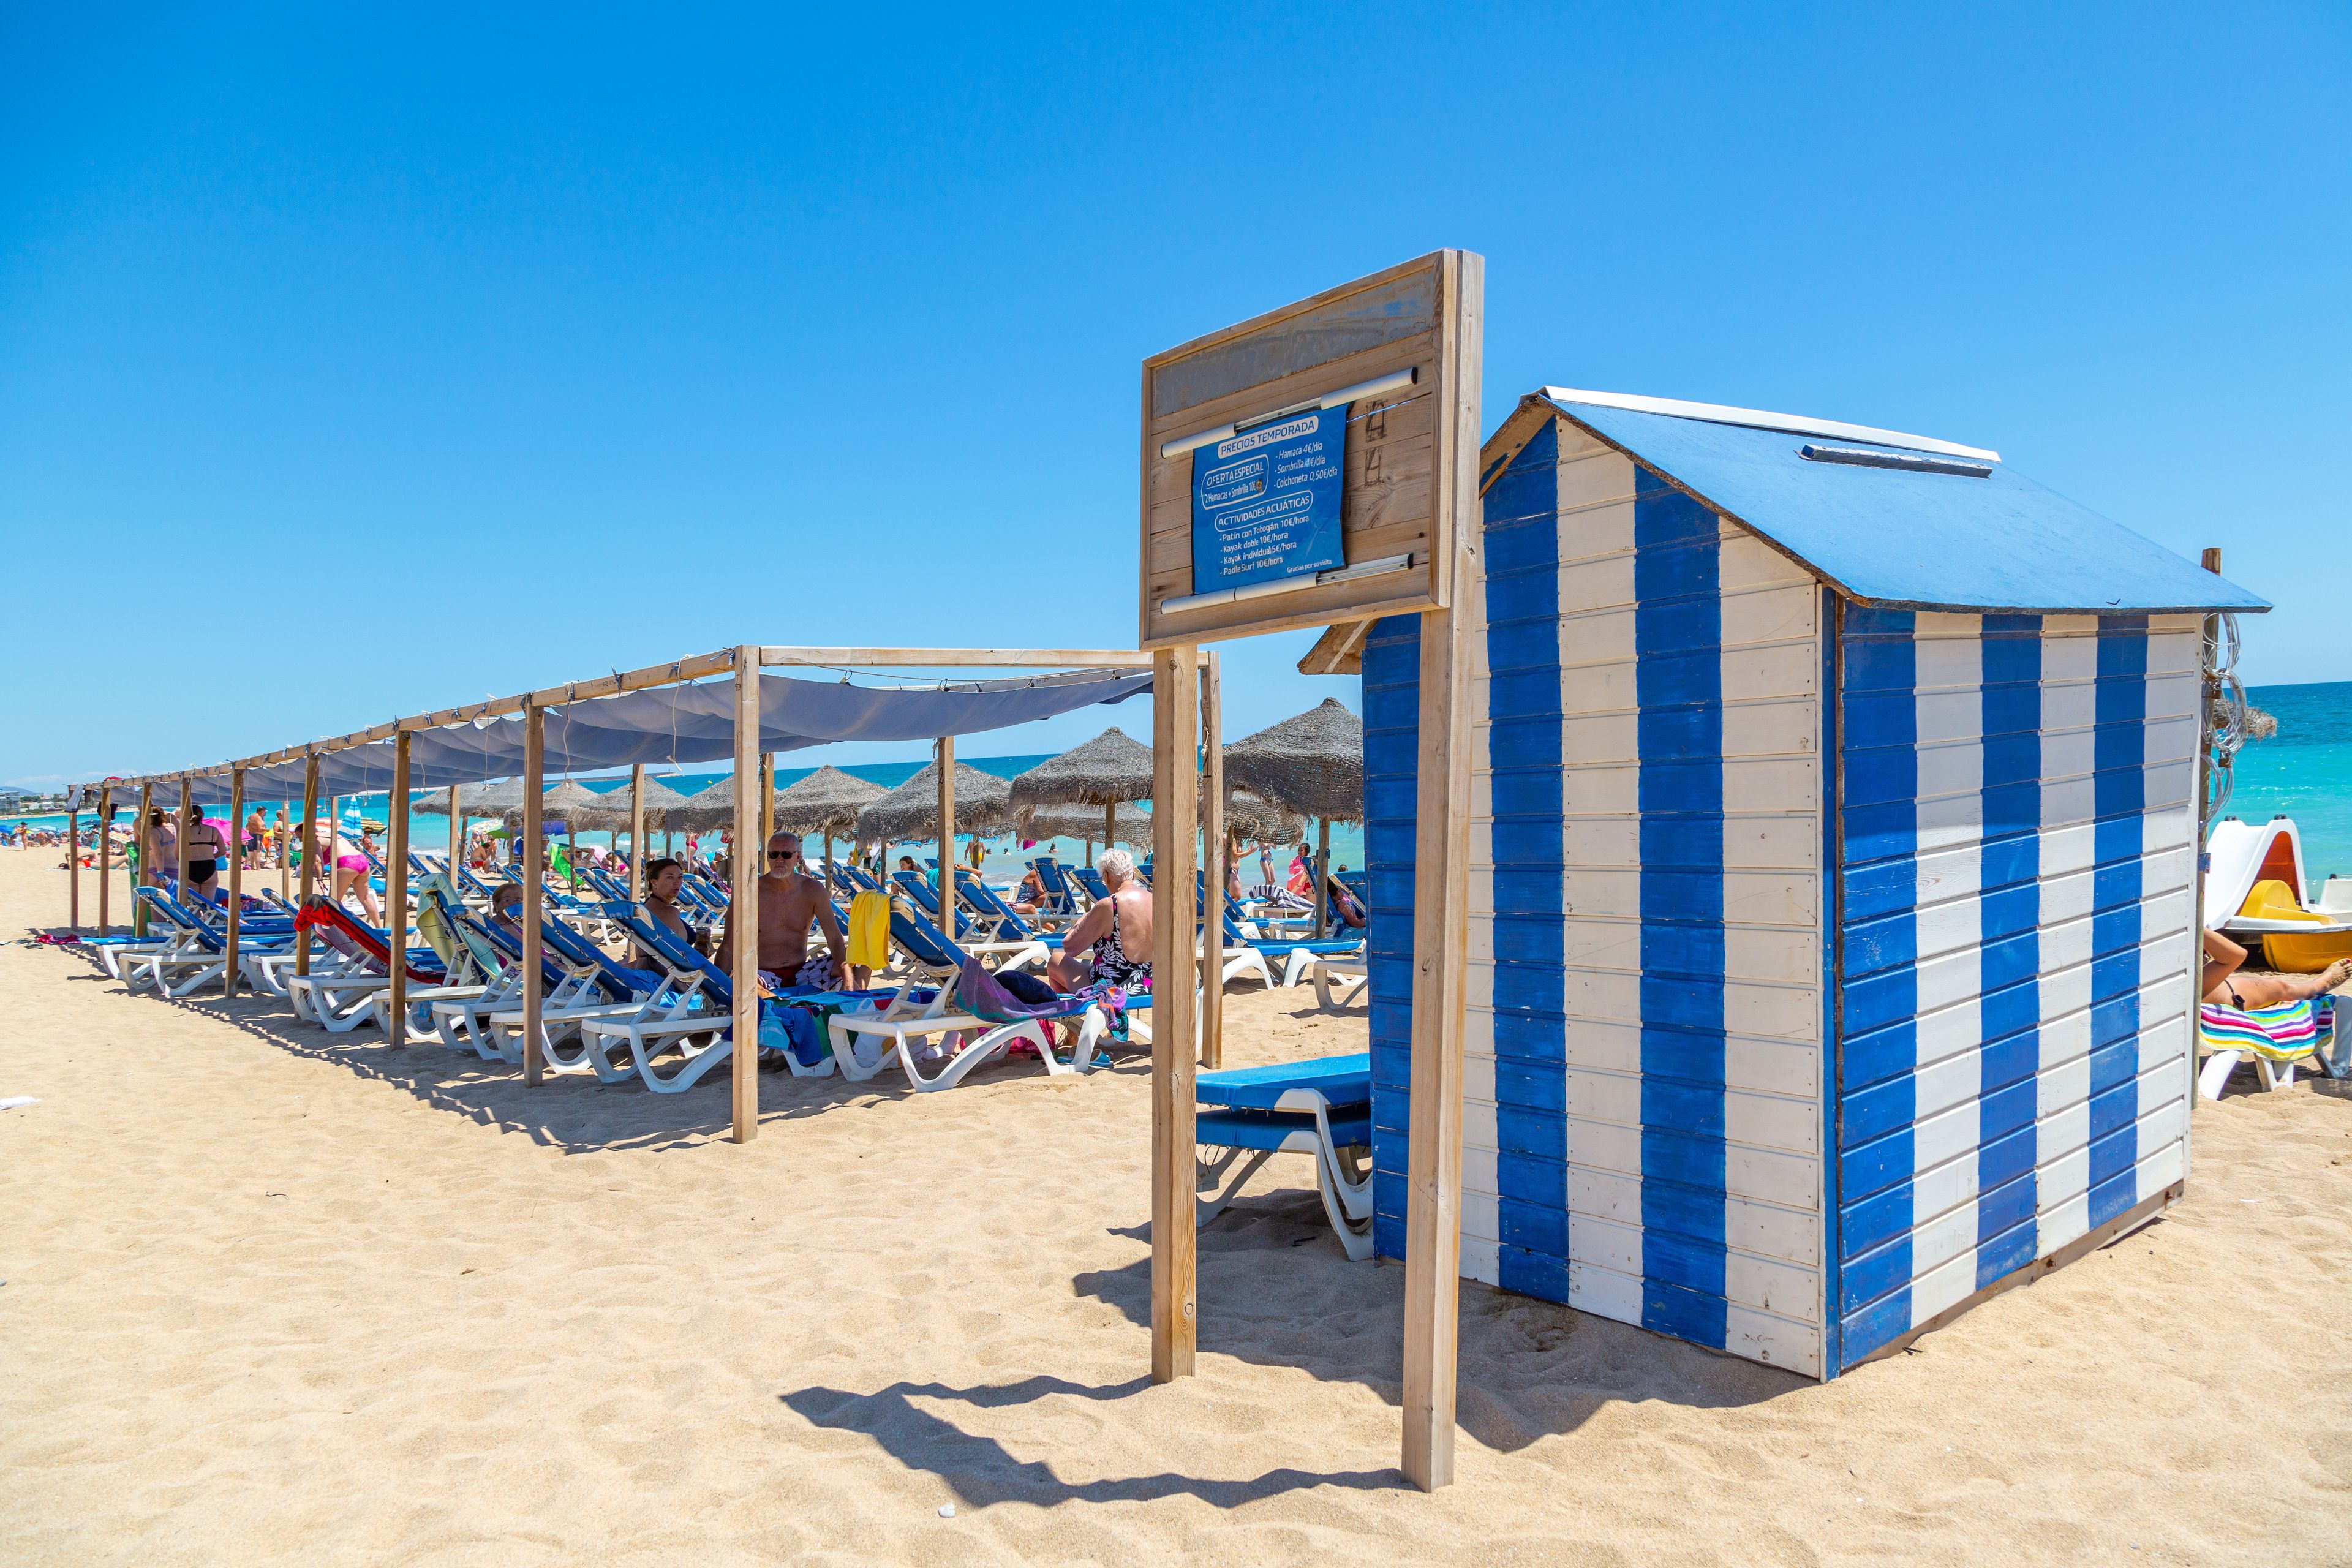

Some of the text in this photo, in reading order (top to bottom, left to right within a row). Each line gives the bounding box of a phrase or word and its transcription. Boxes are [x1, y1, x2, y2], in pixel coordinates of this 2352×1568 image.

[1221, 420, 1314, 455] PRECIOS TEMPORADA
[1278, 441, 1323, 459] Hamaca 4€/día
[1207, 461, 1264, 486] OFERTA ESPECIAL
[1276, 466, 1338, 489] Colchoneta 0,50€/día
[1277, 458, 1305, 474] Sombrilla
[1205, 494, 1208, 503] 2
[1208, 491, 1228, 502] Hamacas
[1231, 483, 1249, 497] Sombrilla
[1218, 496, 1310, 526] ACTIVIDADES ACUÁTICAS
[1222, 516, 1310, 542] Patín con Tobogán 10€/hora
[1223, 532, 1289, 554] Kayak doble 10€/hora
[1223, 541, 1297, 565] Kayak individual 5€/hora
[1223, 557, 1283, 576] Padle Surf 10€/hora
